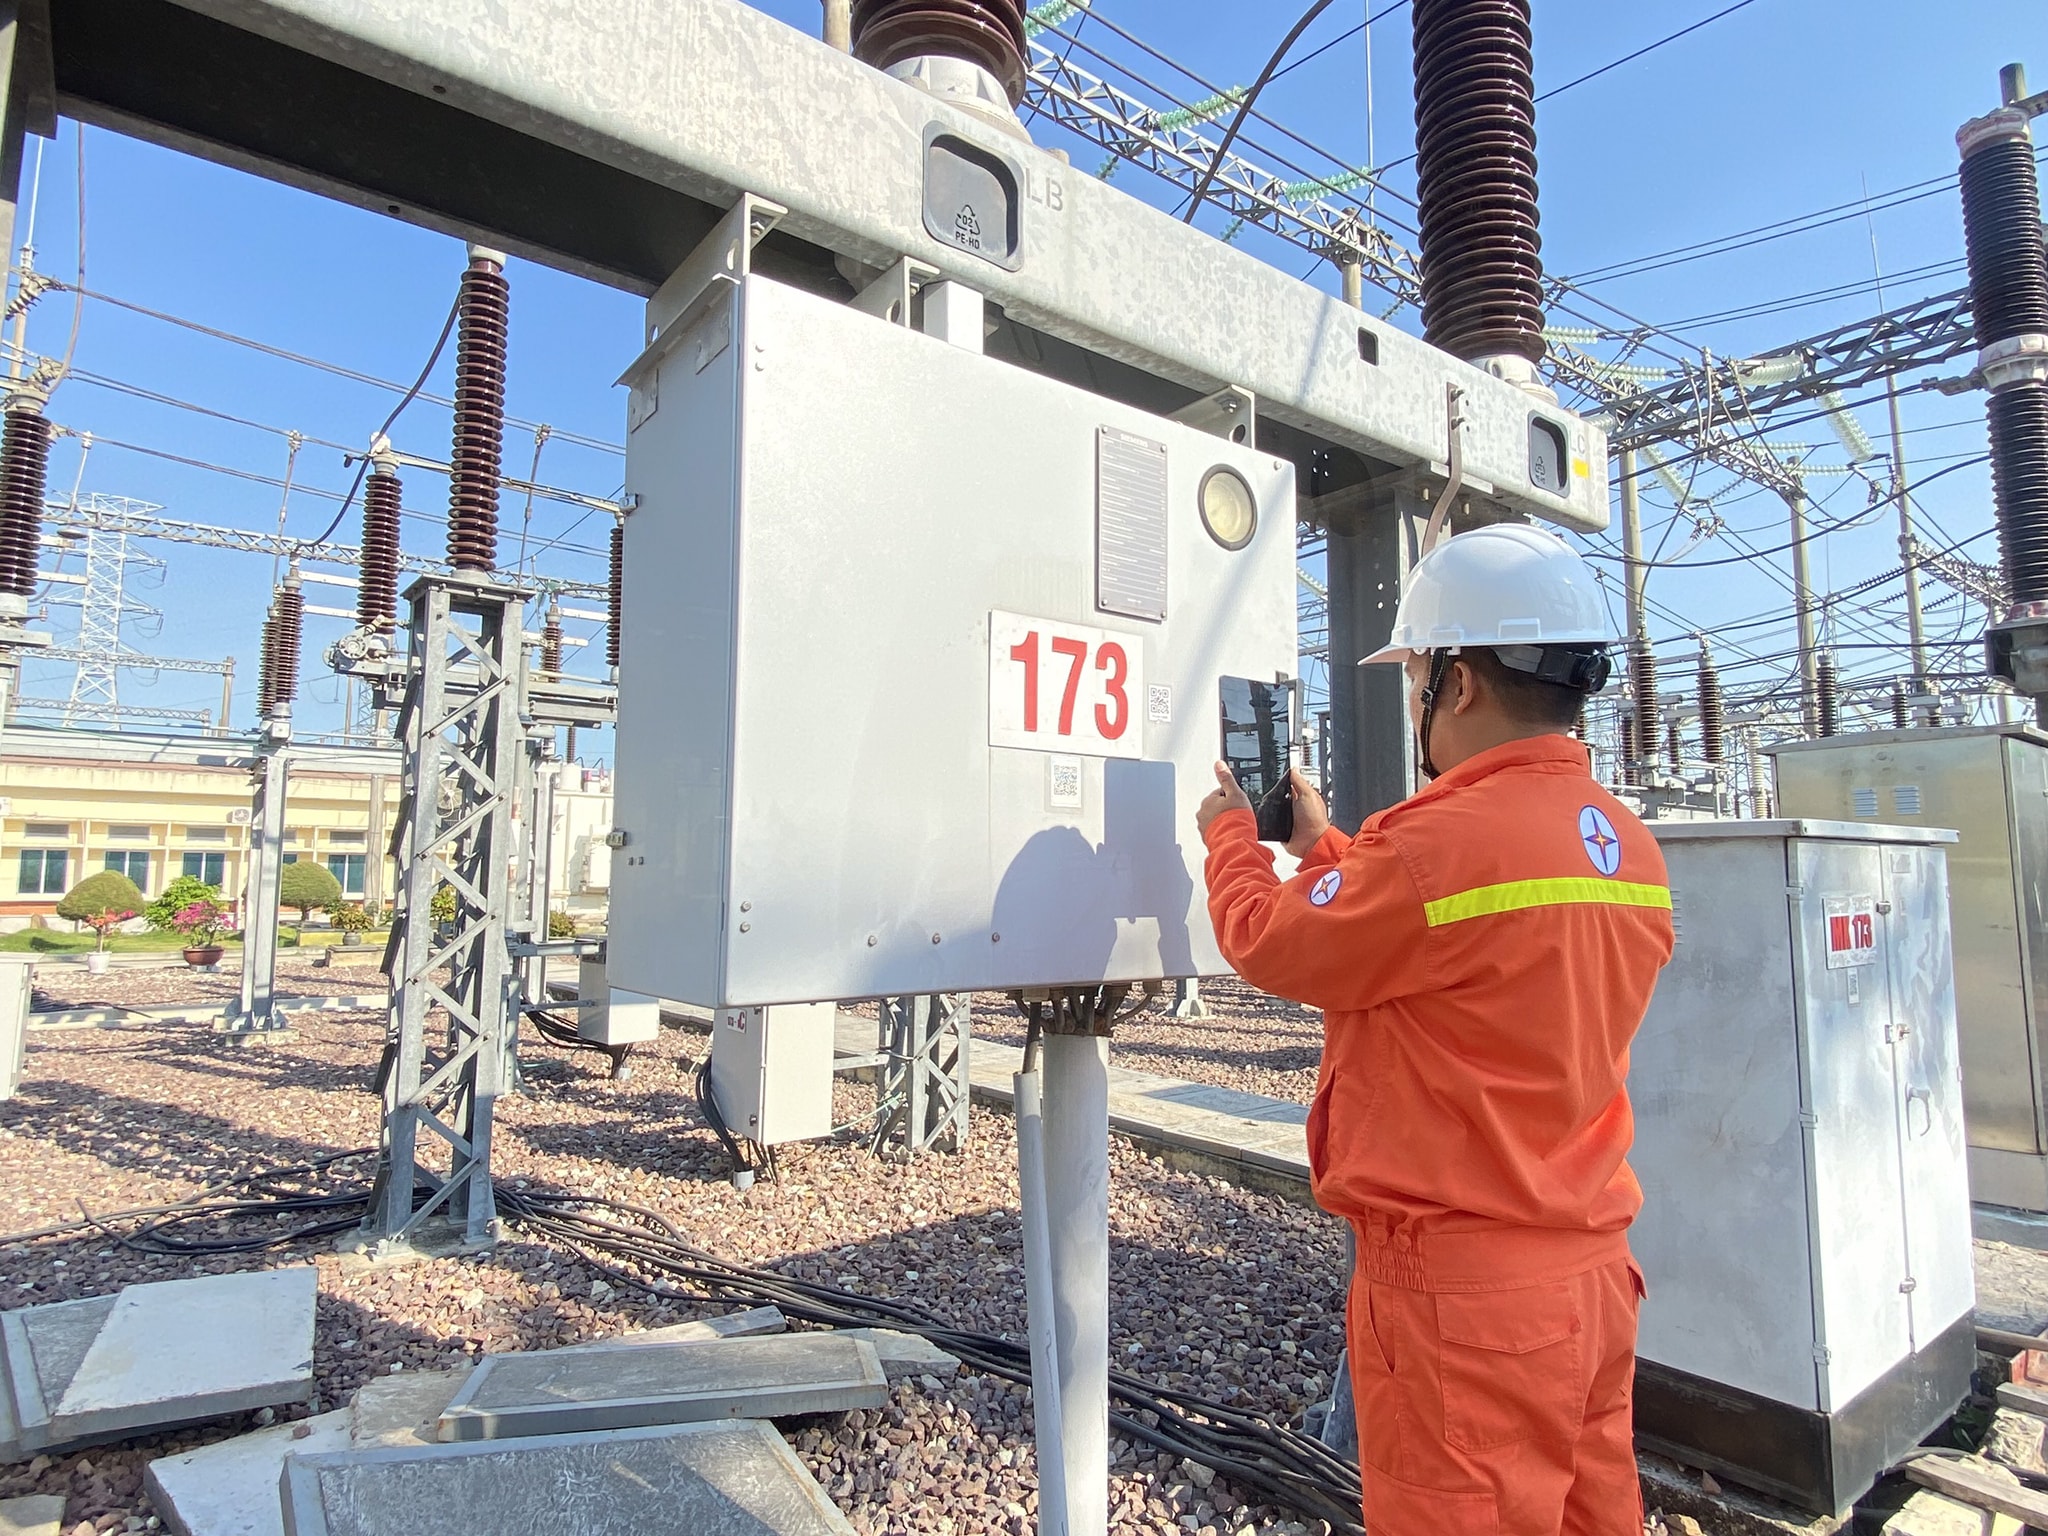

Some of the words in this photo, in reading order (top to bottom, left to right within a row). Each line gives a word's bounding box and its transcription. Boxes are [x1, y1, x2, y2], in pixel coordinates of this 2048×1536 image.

[1025, 167, 1064, 212] LB
[962, 214, 973, 228] 02
[955, 230, 980, 250] PE-HD
[1010, 631, 1128, 740] 173
[1852, 913, 1873, 949] 173
